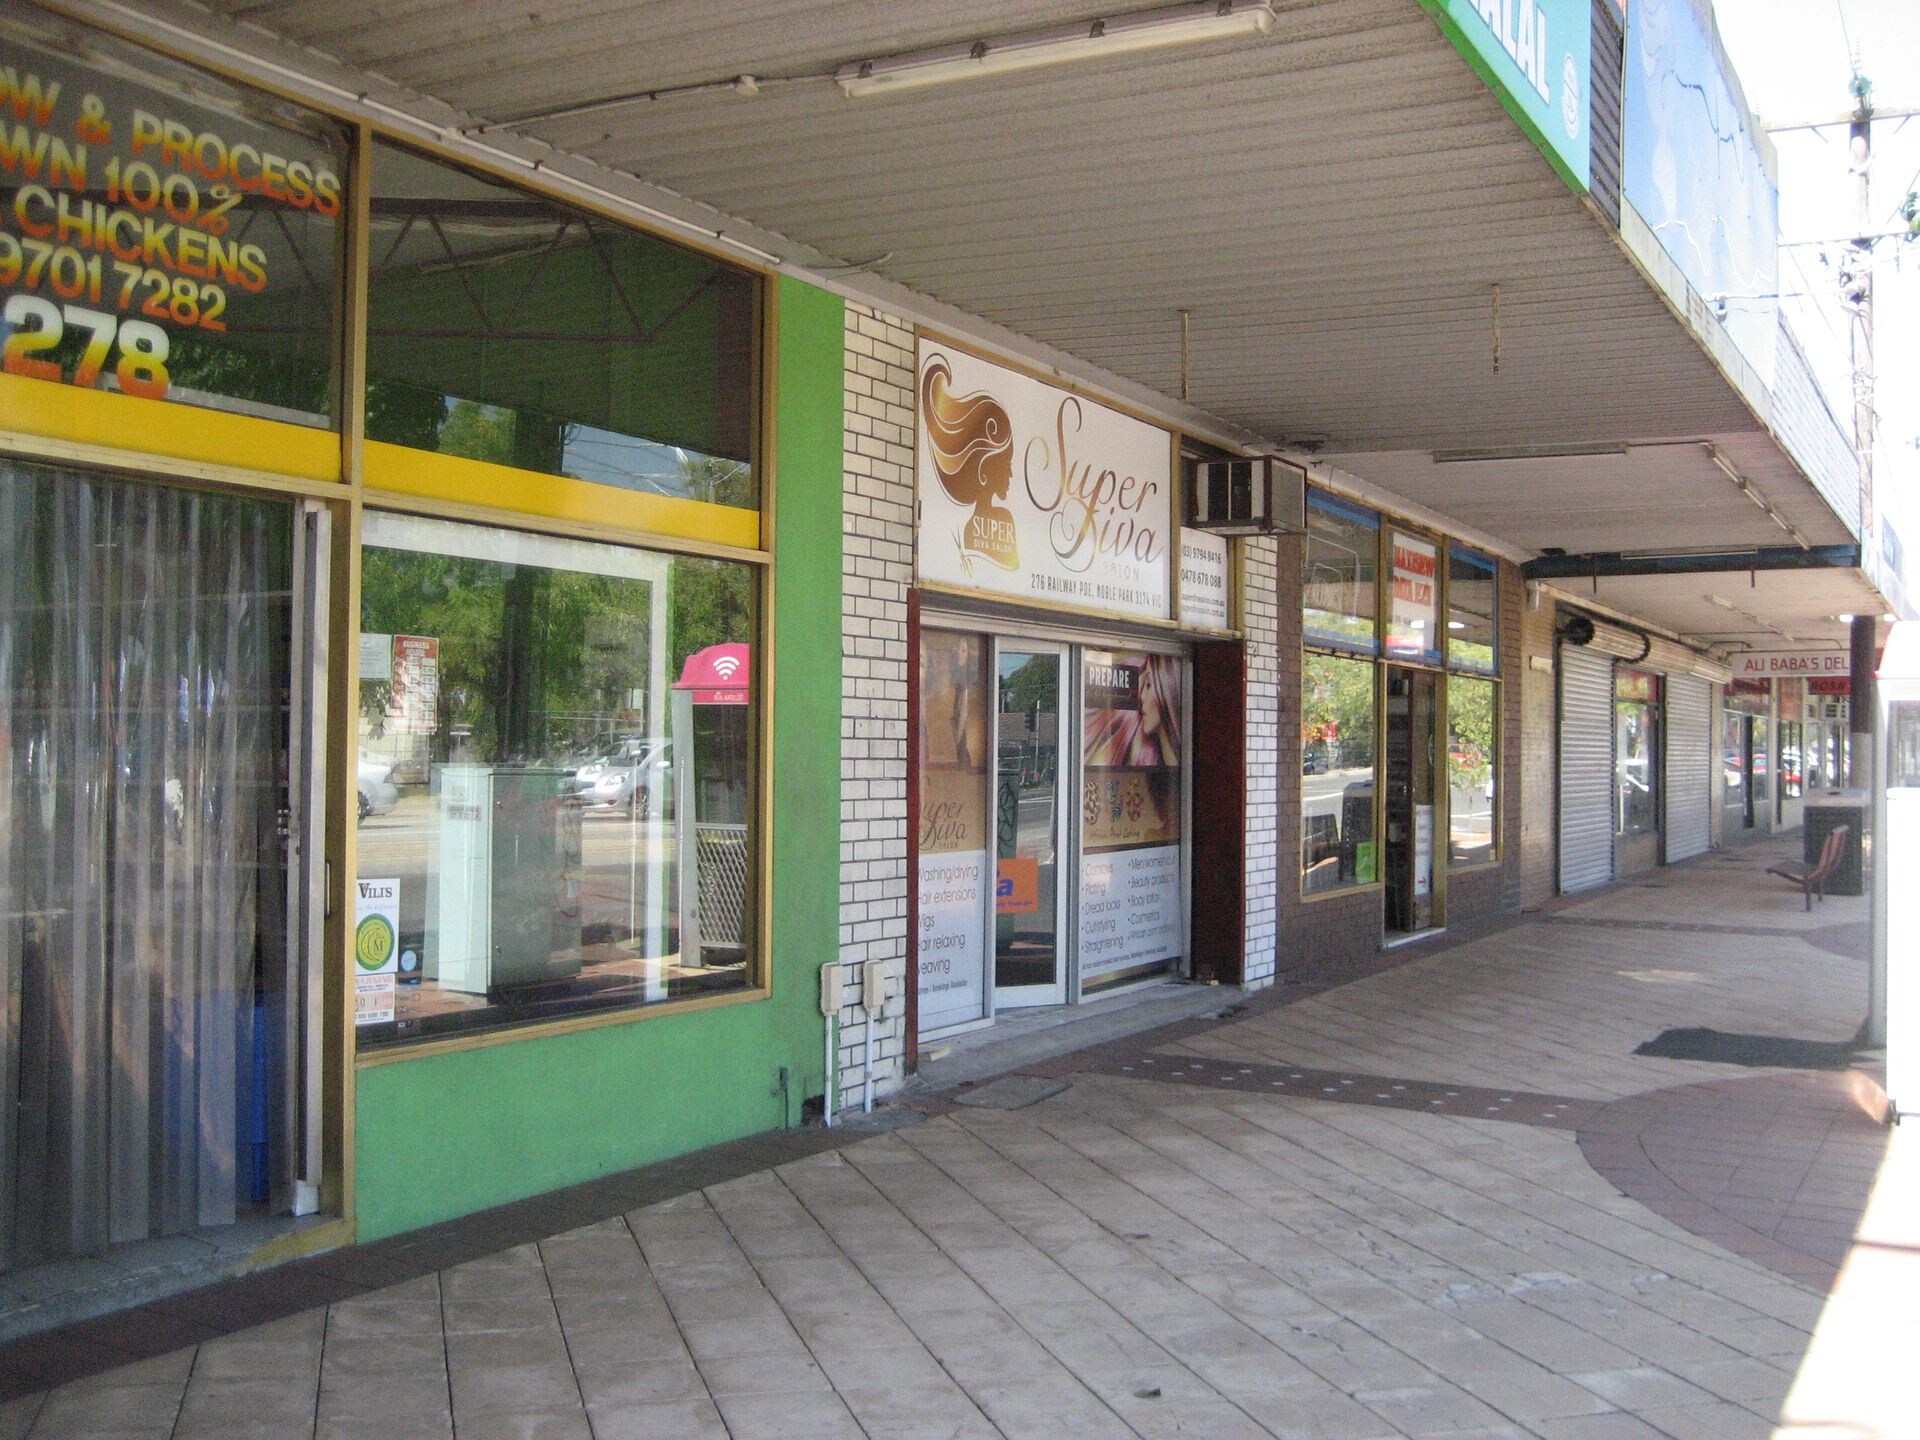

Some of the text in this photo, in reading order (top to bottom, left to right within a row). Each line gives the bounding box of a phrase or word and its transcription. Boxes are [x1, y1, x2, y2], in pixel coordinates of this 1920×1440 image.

[0, 66, 341, 217] W & PROCESS
[105, 155, 243, 234] 100%
[15, 184, 267, 293] CHICKENS
[0, 231, 227, 331] 9701 7282
[3, 294, 171, 401] 278
[1024, 396, 1157, 512] Super
[972, 515, 1015, 543] SUPER
[1049, 496, 1163, 573] Diva
[1031, 573, 1045, 590] 276
[1047, 576, 1077, 596] RAILWAY
[1096, 585, 1116, 600] NOBLE
[1118, 588, 1134, 603] PARK
[1135, 590, 1150, 606] 3174
[1089, 666, 1130, 689] PREPARE
[1744, 659, 1765, 672] ALI
[1770, 657, 1819, 671] BABA'S
[919, 915, 935, 932] igs
[919, 934, 966, 952] air relaxing
[919, 959, 951, 975] eaving
